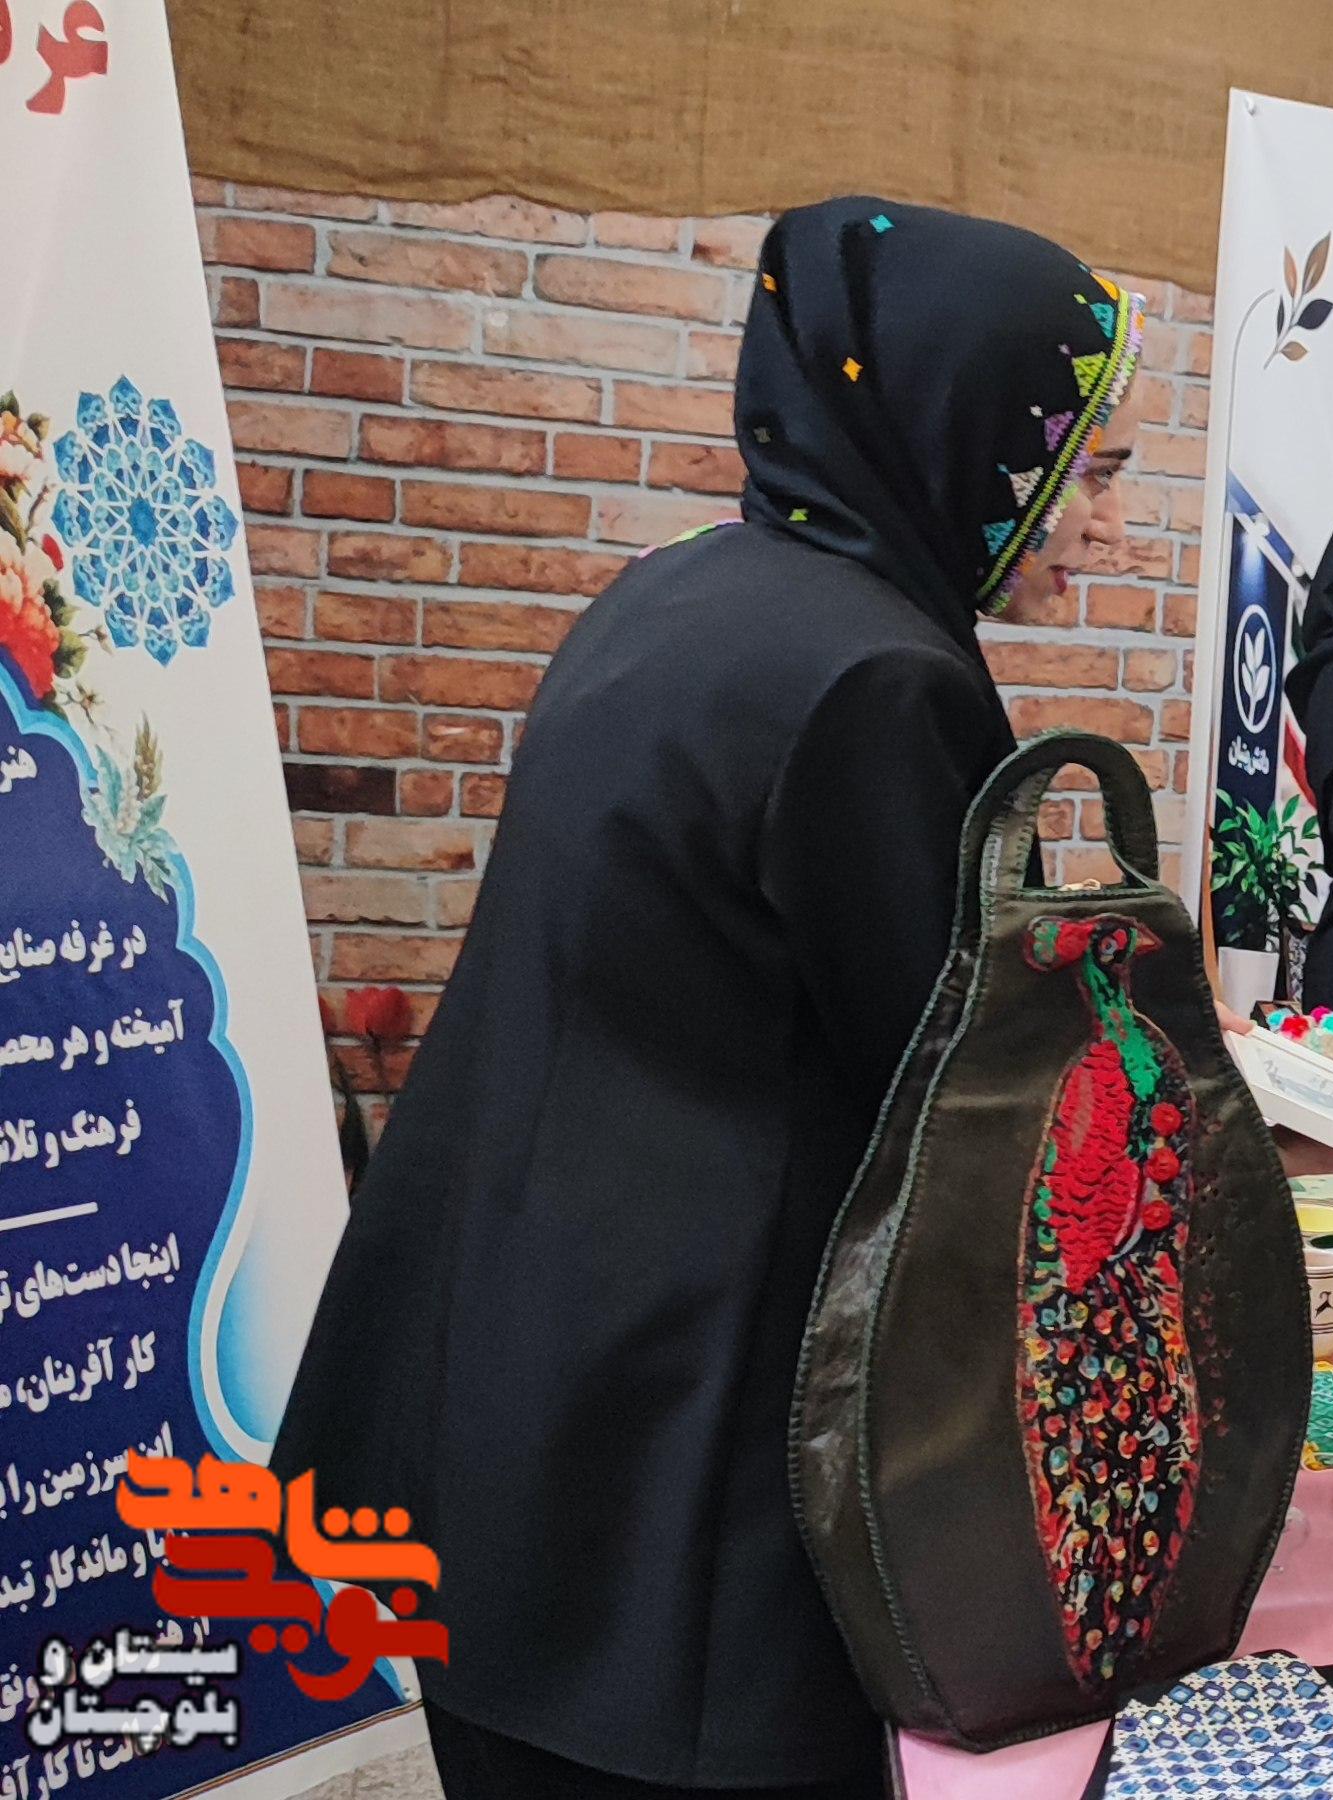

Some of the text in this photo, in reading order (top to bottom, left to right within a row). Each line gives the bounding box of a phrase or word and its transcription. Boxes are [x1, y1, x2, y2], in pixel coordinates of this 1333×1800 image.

[60, 918, 116, 974] غرفه
[120, 924, 148, 970] در
[0, 998, 184, 1071] آمیخته و هر محص
[0, 1098, 142, 1169] فرهنگ و تلا
[120, 1231, 181, 1290] اینجا
[123, 1330, 156, 1391] کار
[6, 1462, 37, 1516] را
[41, 1533, 128, 1609] ماندگار
[132, 1541, 147, 1579] و
